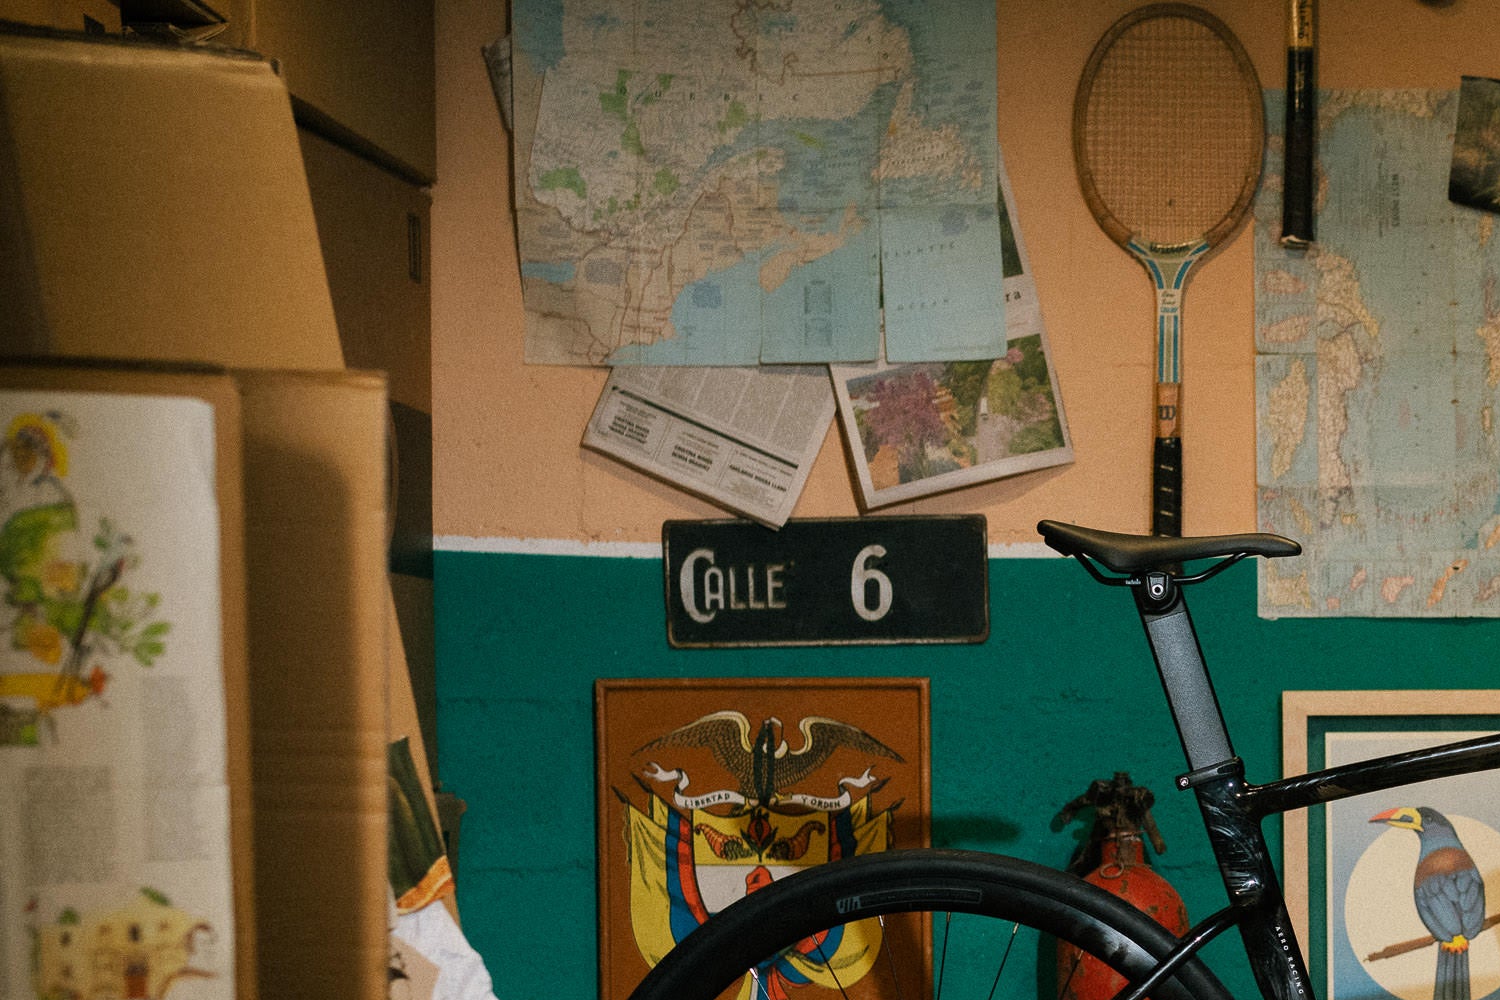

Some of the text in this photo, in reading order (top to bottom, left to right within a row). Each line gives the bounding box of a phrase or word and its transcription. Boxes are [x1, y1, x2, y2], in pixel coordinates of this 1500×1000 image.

[851, 544, 893, 621] 6
[684, 792, 731, 808] LIBERTAD
[810, 798, 842, 809] ORDEN
[1275, 926, 1289, 951] AERO
[1287, 956, 1304, 994] RACING
